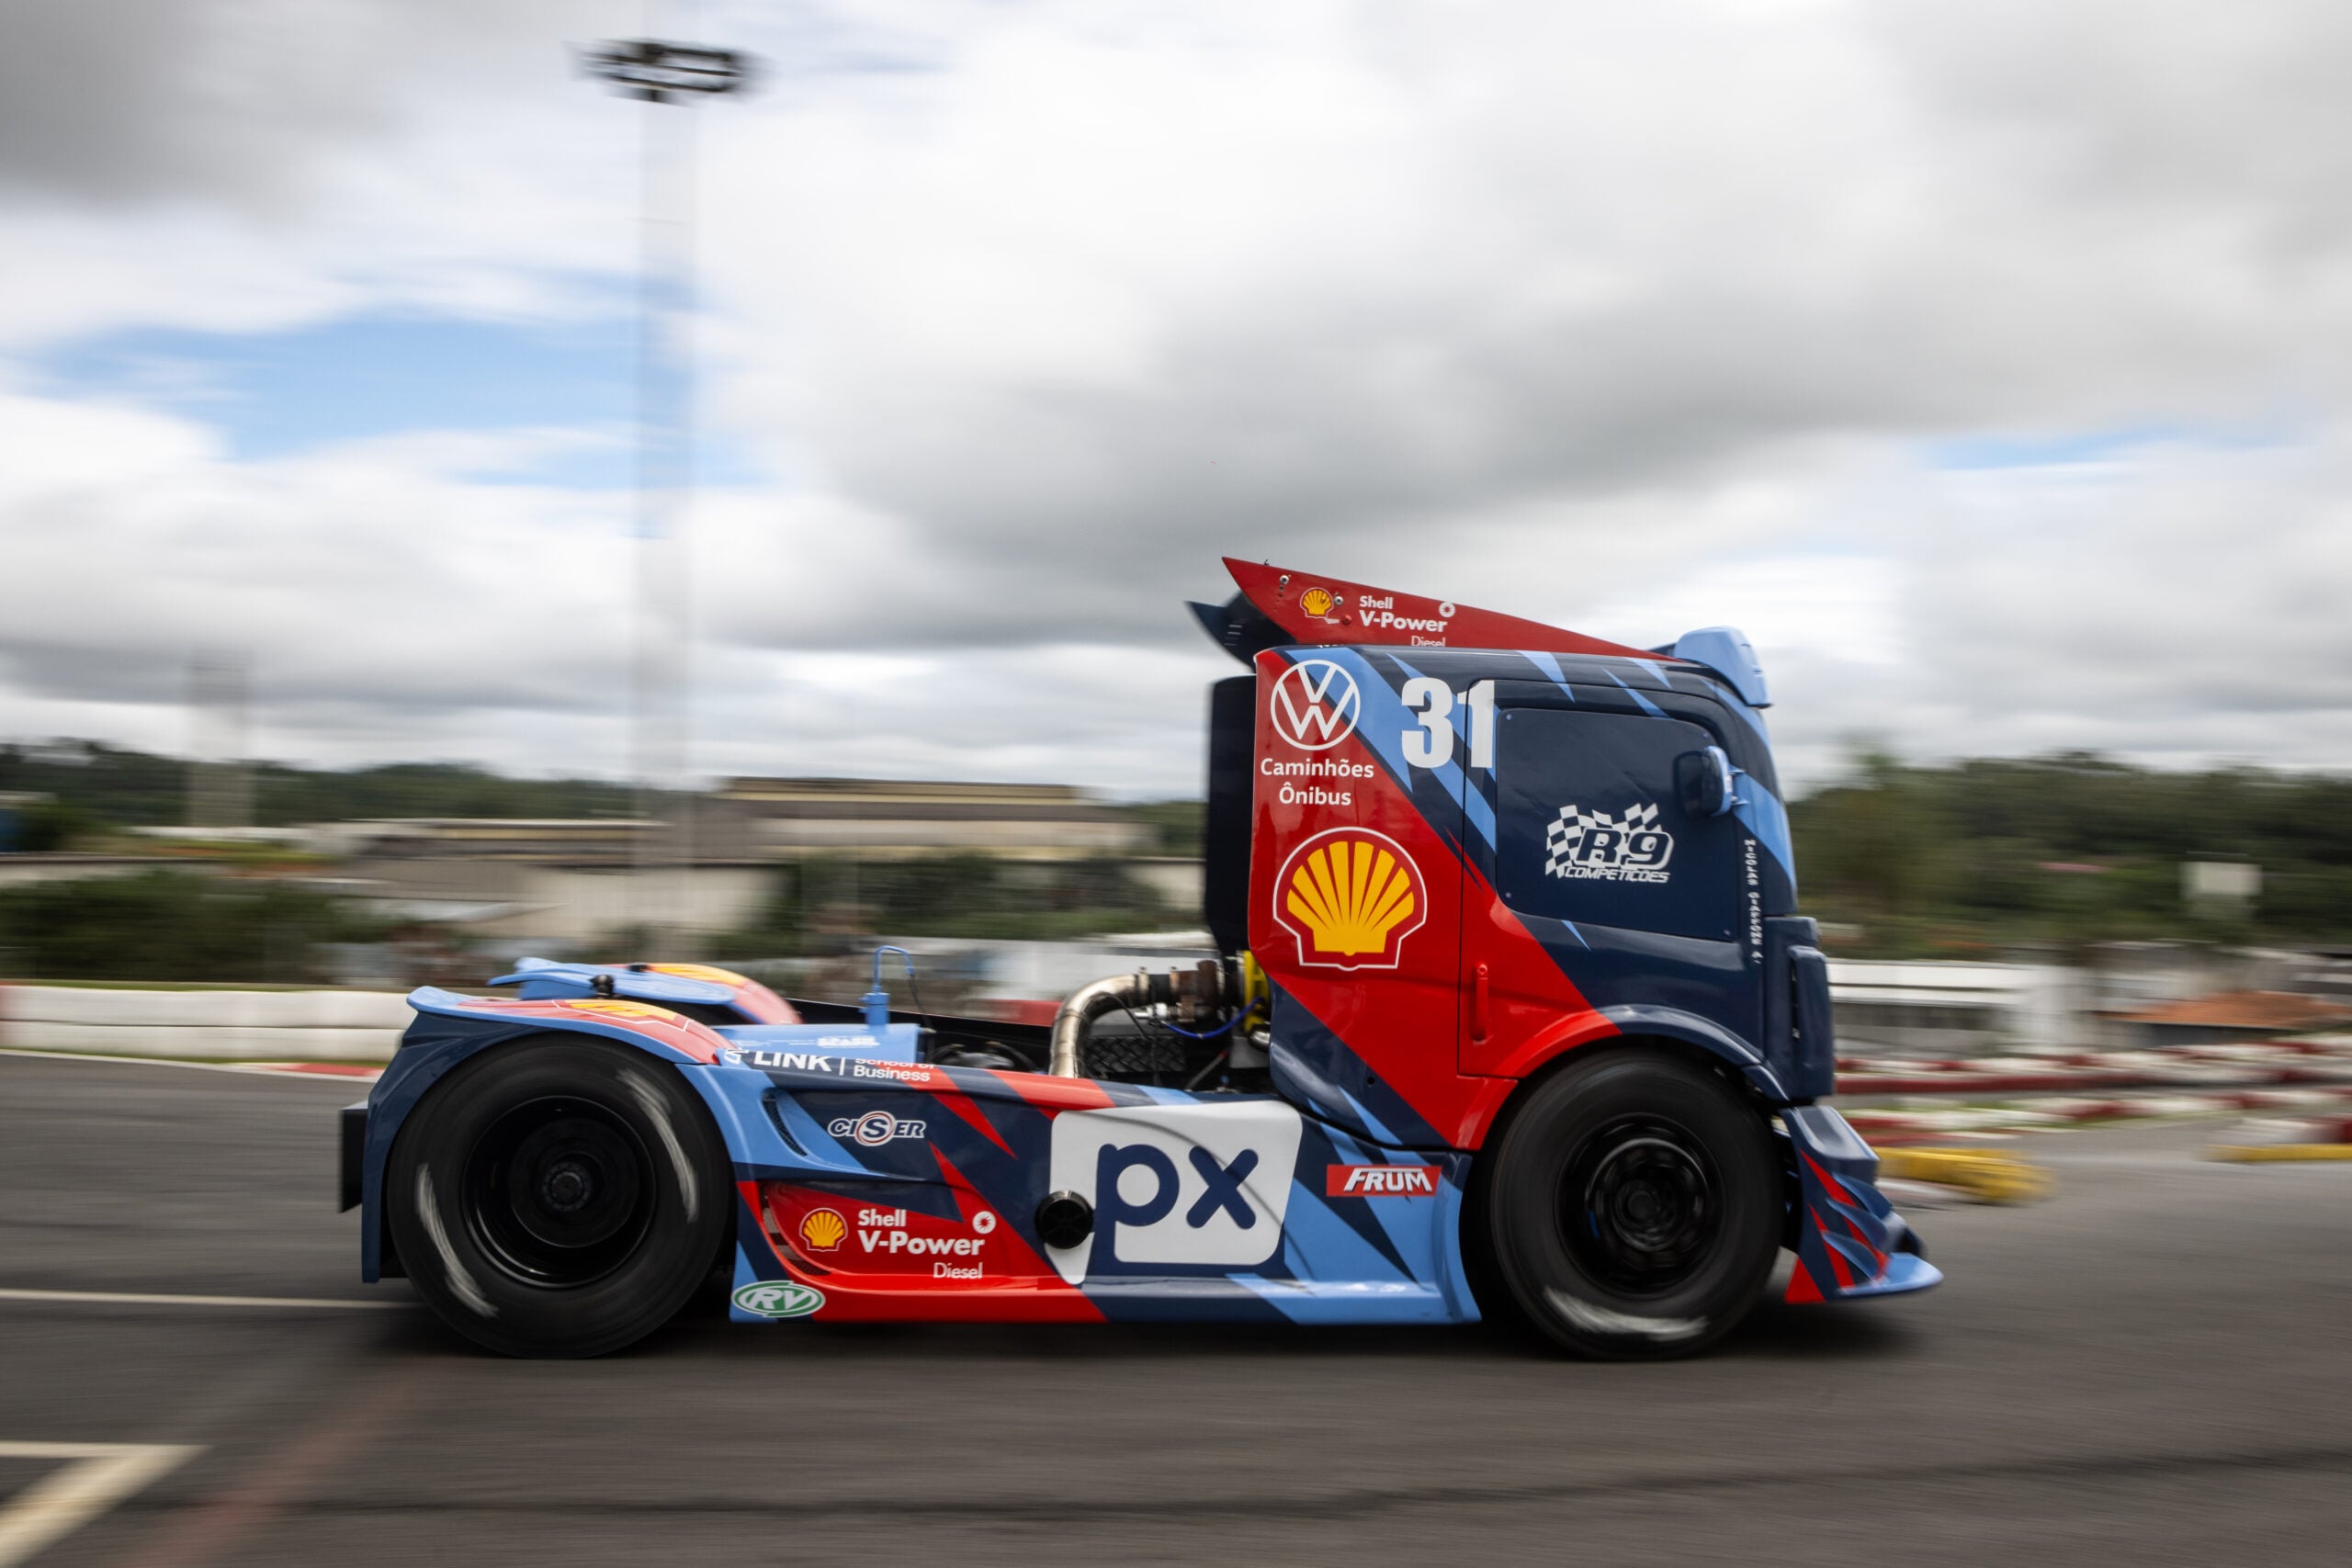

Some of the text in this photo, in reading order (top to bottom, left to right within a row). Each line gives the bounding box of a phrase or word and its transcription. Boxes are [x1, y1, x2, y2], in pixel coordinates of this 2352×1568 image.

[1359, 595, 1393, 610] Shell
[1359, 610, 1448, 632] V-Power
[1411, 636, 1446, 647] Diesel
[1401, 677, 1495, 769] 31
[1261, 758, 1374, 779] Caminhões
[1279, 783, 1351, 806] Ônibus
[1576, 828, 1674, 871] R9
[1744, 840, 1758, 886] NICOLAS
[754, 1051, 831, 1072] LINK
[854, 1066, 931, 1082] Business
[829, 1113, 926, 1143] CISER
[1344, 1168, 1432, 1192] FRUM
[858, 1209, 906, 1227] Shell
[1088, 1143, 1259, 1277] px
[857, 1230, 985, 1256] V-Power
[933, 1262, 983, 1279] Diesel
[746, 1289, 811, 1310] RV
